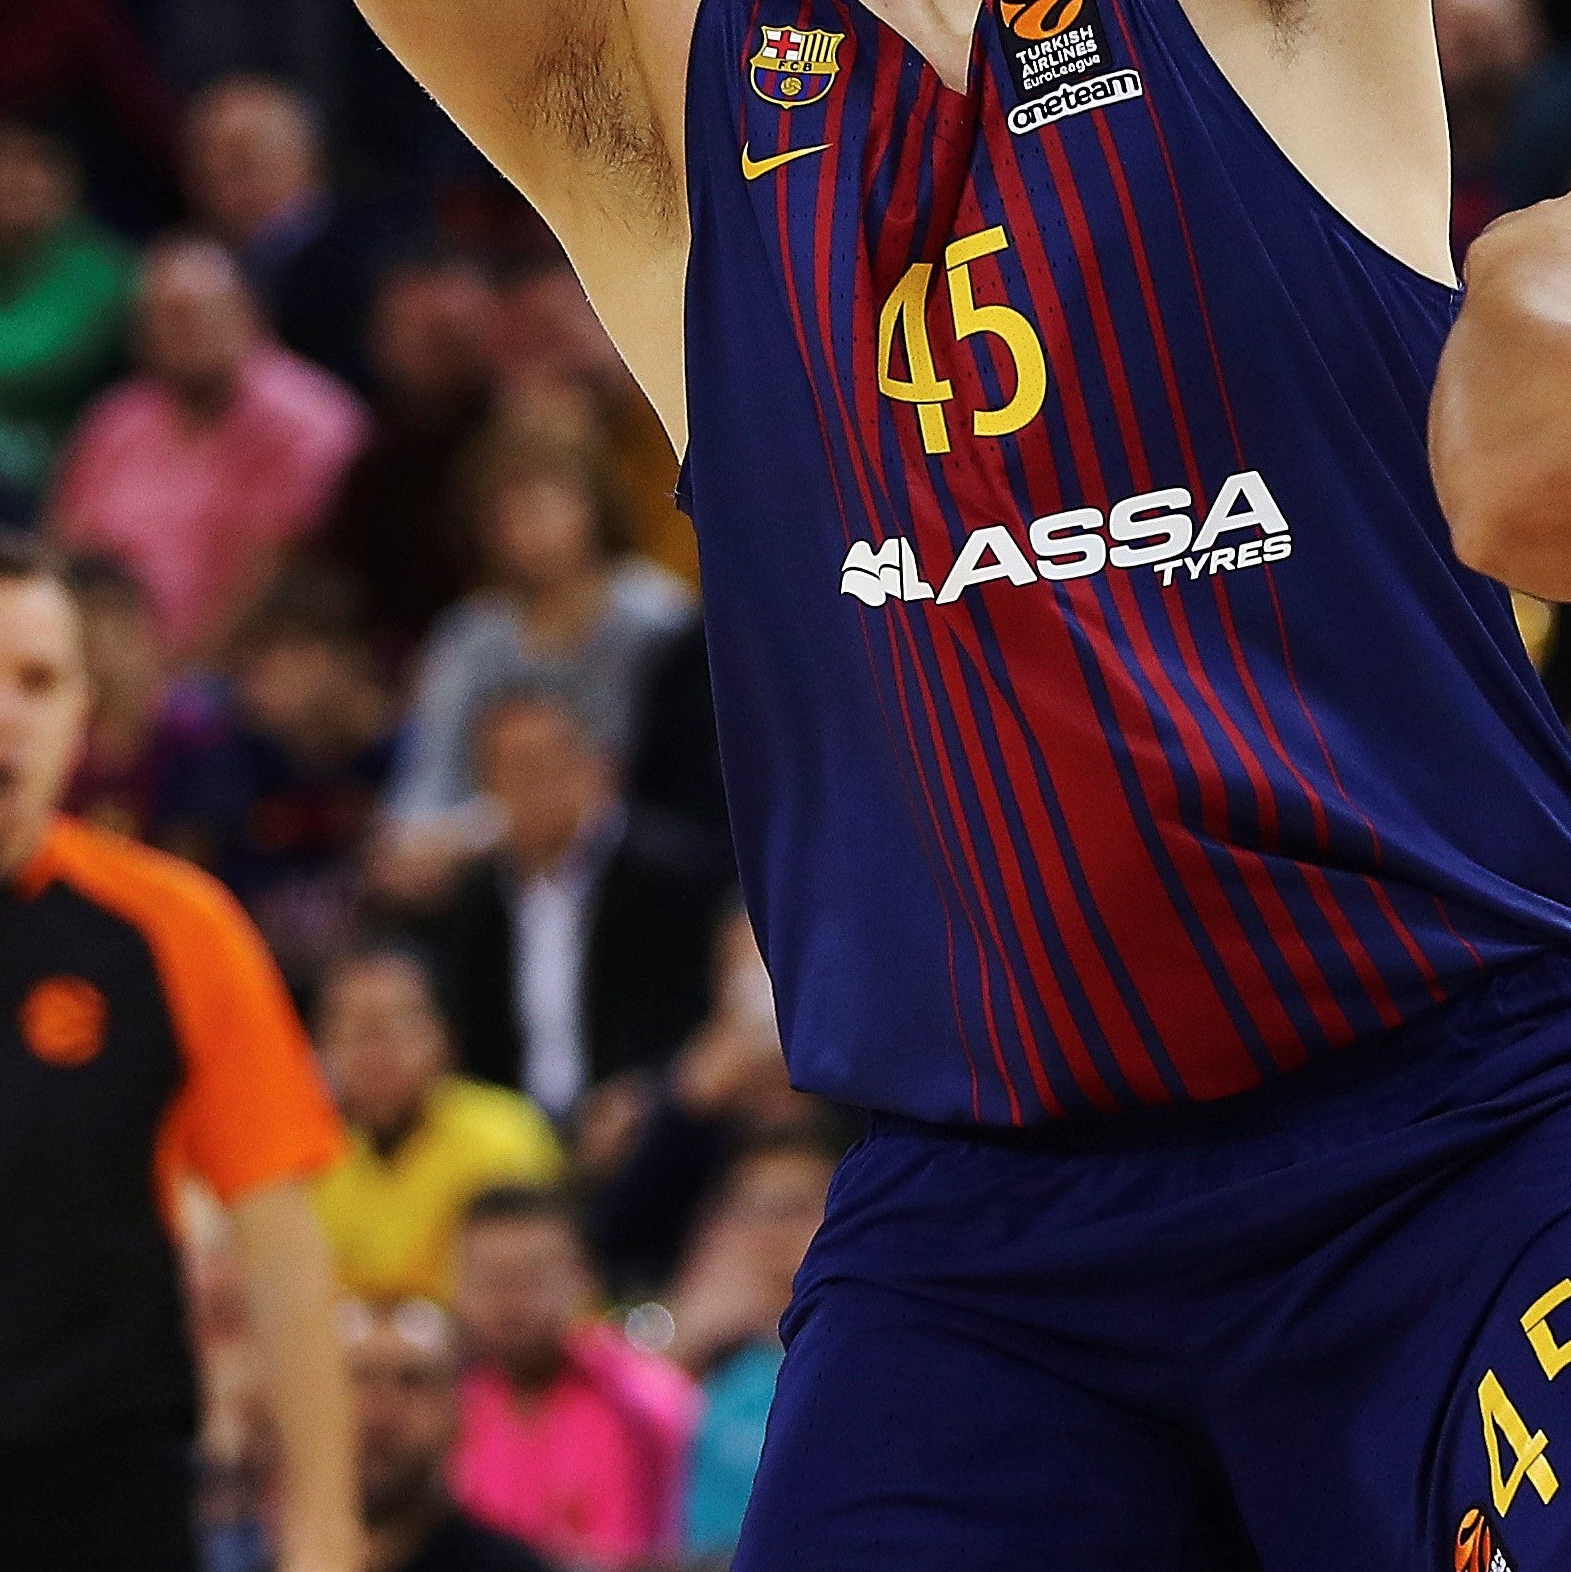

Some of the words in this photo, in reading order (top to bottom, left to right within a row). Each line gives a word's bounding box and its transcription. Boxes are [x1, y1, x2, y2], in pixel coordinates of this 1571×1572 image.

[1015, 24, 1094, 64] TURKISH
[1022, 39, 1098, 79] AIRLINES
[1013, 73, 1139, 128] oneteam
[878, 225, 1047, 455] 45
[901, 470, 1289, 605] LASSA
[1153, 534, 1292, 587] TYRES
